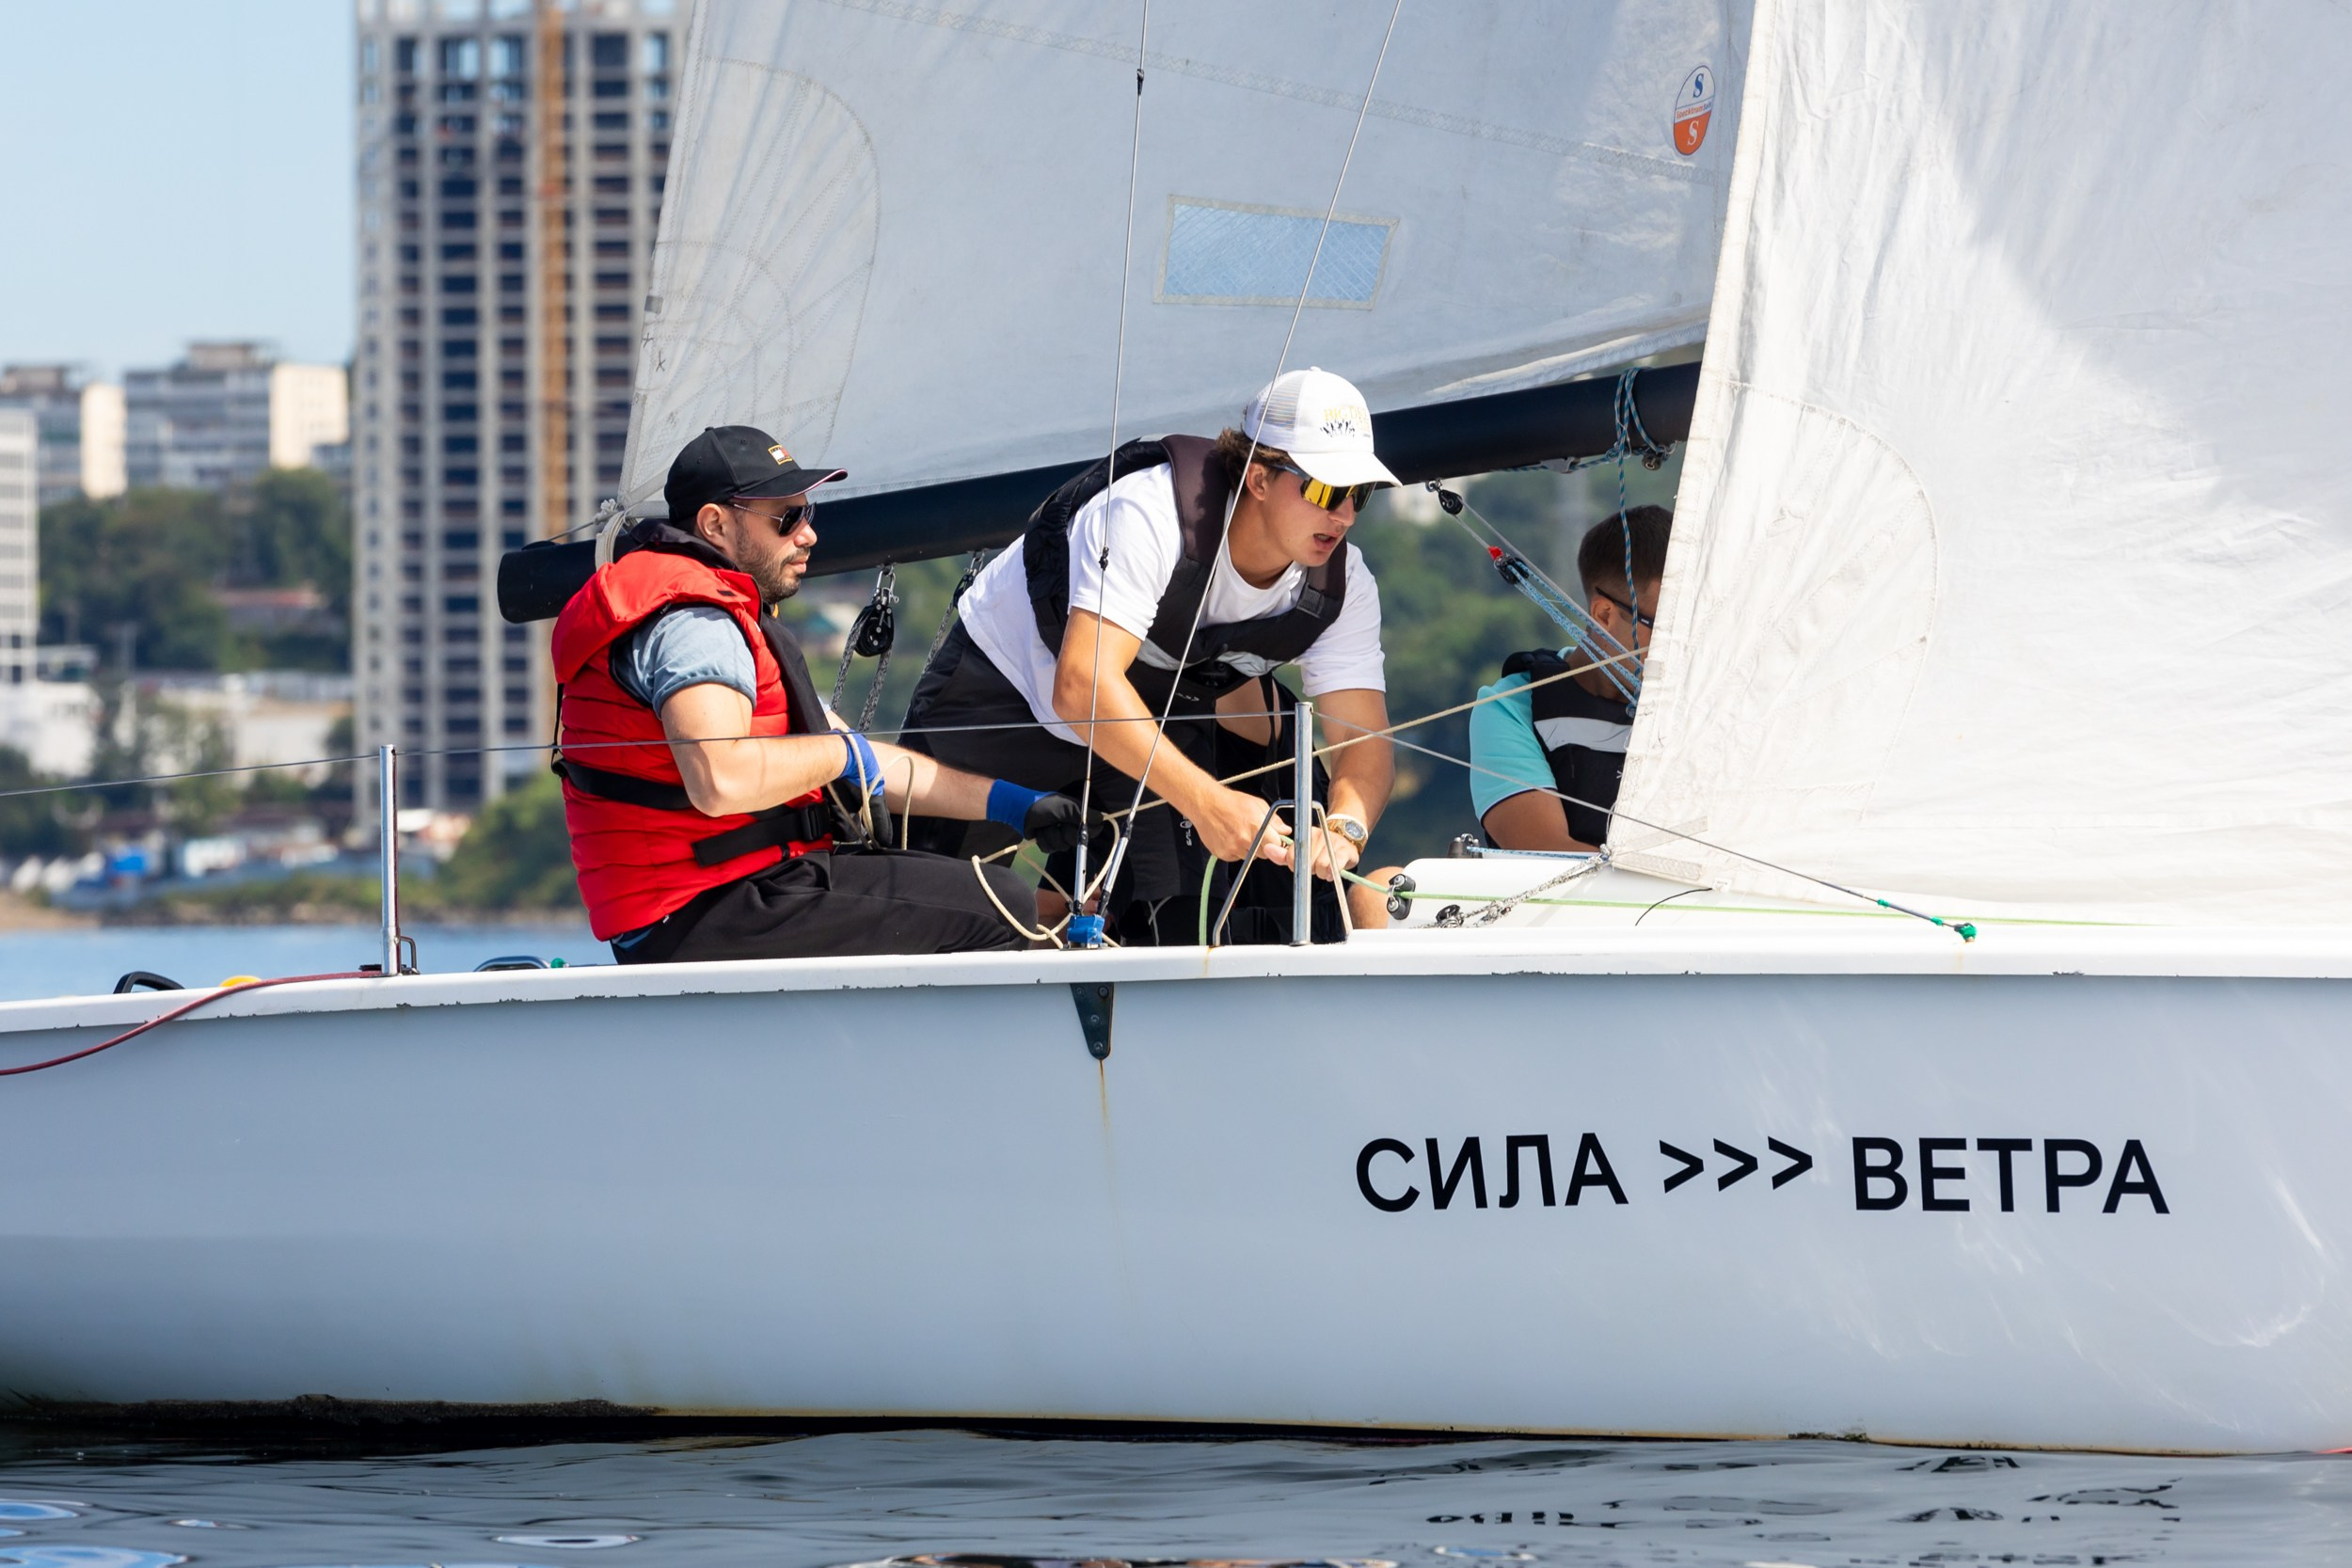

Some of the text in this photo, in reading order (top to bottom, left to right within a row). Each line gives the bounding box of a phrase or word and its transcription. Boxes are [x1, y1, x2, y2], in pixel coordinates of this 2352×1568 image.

[1692, 73, 1704, 98] S
[1687, 120, 1699, 146] S
[1357, 1132, 1629, 1212] СИЛА
[1852, 1137, 2169, 1213] ВЕТРА
